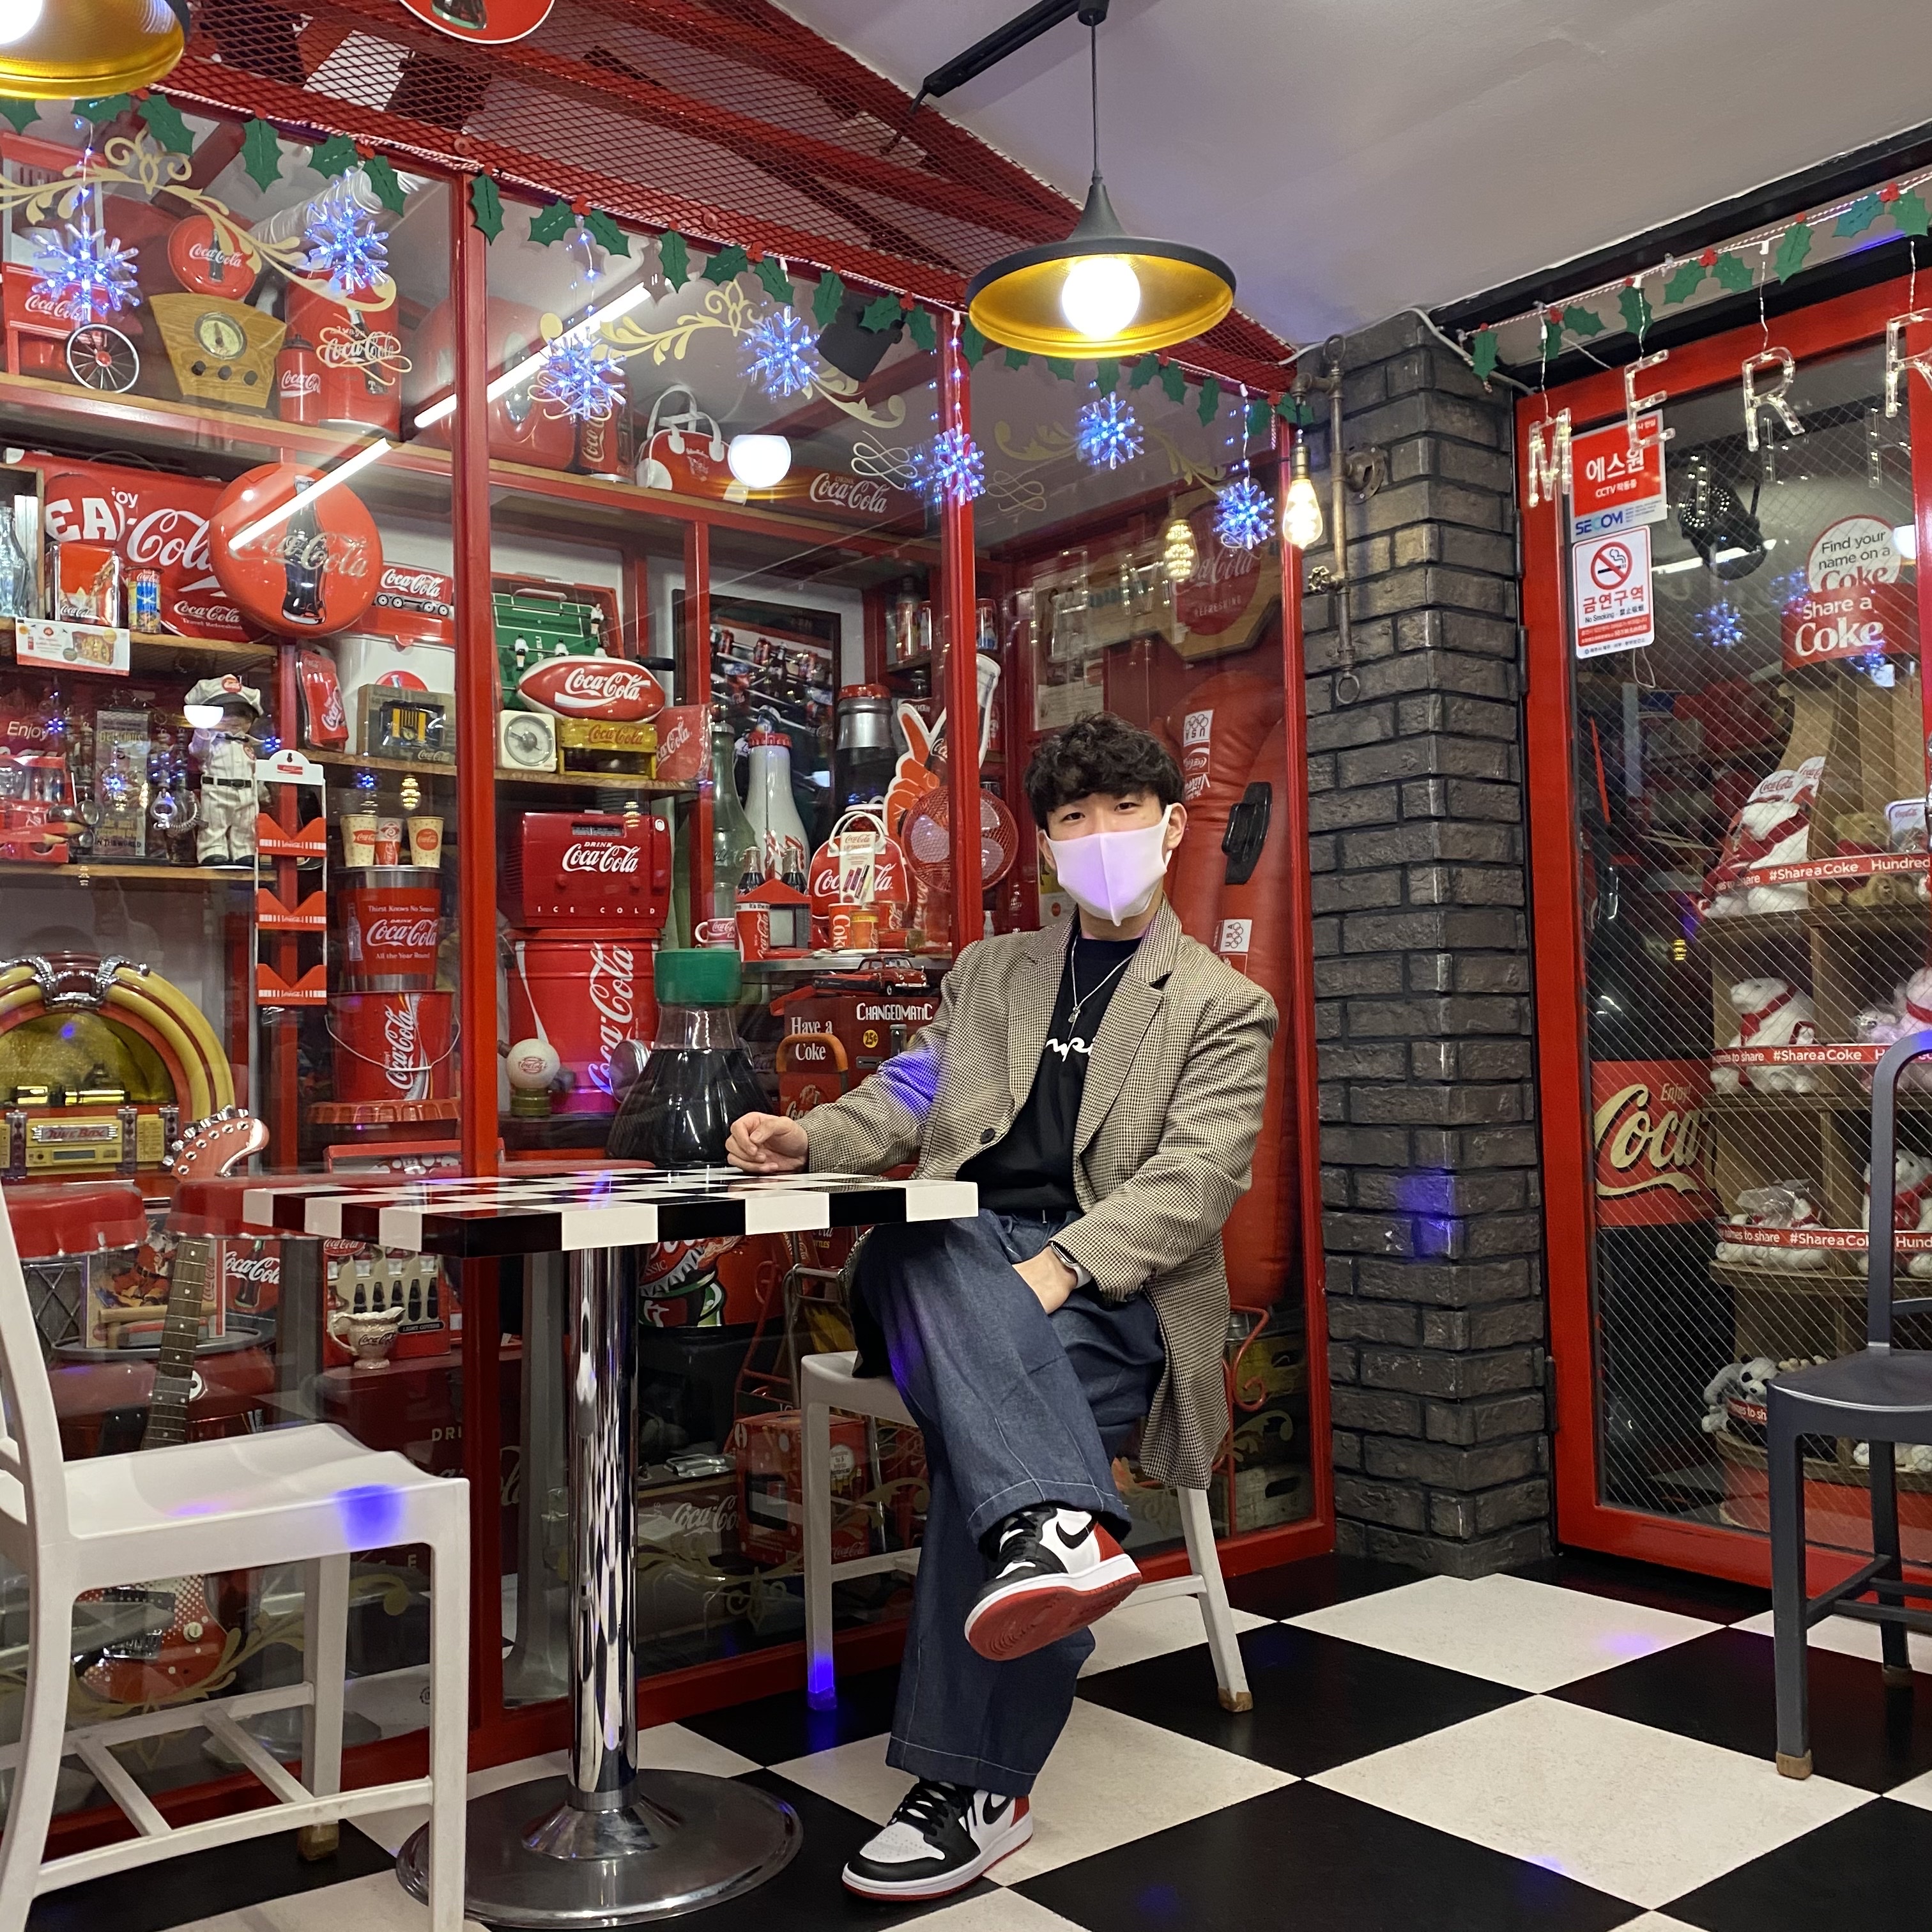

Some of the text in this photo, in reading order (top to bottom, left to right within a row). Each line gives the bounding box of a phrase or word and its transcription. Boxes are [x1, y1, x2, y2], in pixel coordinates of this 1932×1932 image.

[189, 243, 242, 268] Coca-Cola
[1585, 447, 1644, 482] 에스원
[809, 472, 887, 514] Coca-Cola
[1595, 484, 1617, 498] CCTV
[1575, 510, 1623, 535] SECOM
[1821, 532, 1886, 553] Find your
[1818, 546, 1891, 572] name on a
[380, 568, 441, 599] Coca-Cola
[1820, 565, 1889, 593] Coke
[174, 600, 240, 624] Coca-Cola
[1583, 585, 1644, 614] 금연구역
[1802, 596, 1873, 621] Share a
[1593, 611, 1614, 622] Smoking
[1795, 617, 1884, 657] Coke
[565, 668, 643, 701] Coca-Cola
[7, 721, 49, 742] Enjoy
[588, 723, 643, 745] Coca-Cola
[656, 719, 691, 769] ca-Cola
[1759, 775, 1793, 793] Coca-Cola
[562, 841, 641, 874] Coca-Cola
[599, 907, 656, 915] COLD
[366, 919, 438, 947] Coca-Cola
[856, 1002, 933, 1021] CHANGEOMATIC
[790, 1016, 833, 1034] Have a
[384, 1004, 416, 1091] Coca-Cola
[795, 1043, 827, 1061] Coke
[1742, 1051, 1765, 1062] share
[1754, 1230, 1781, 1243] share
